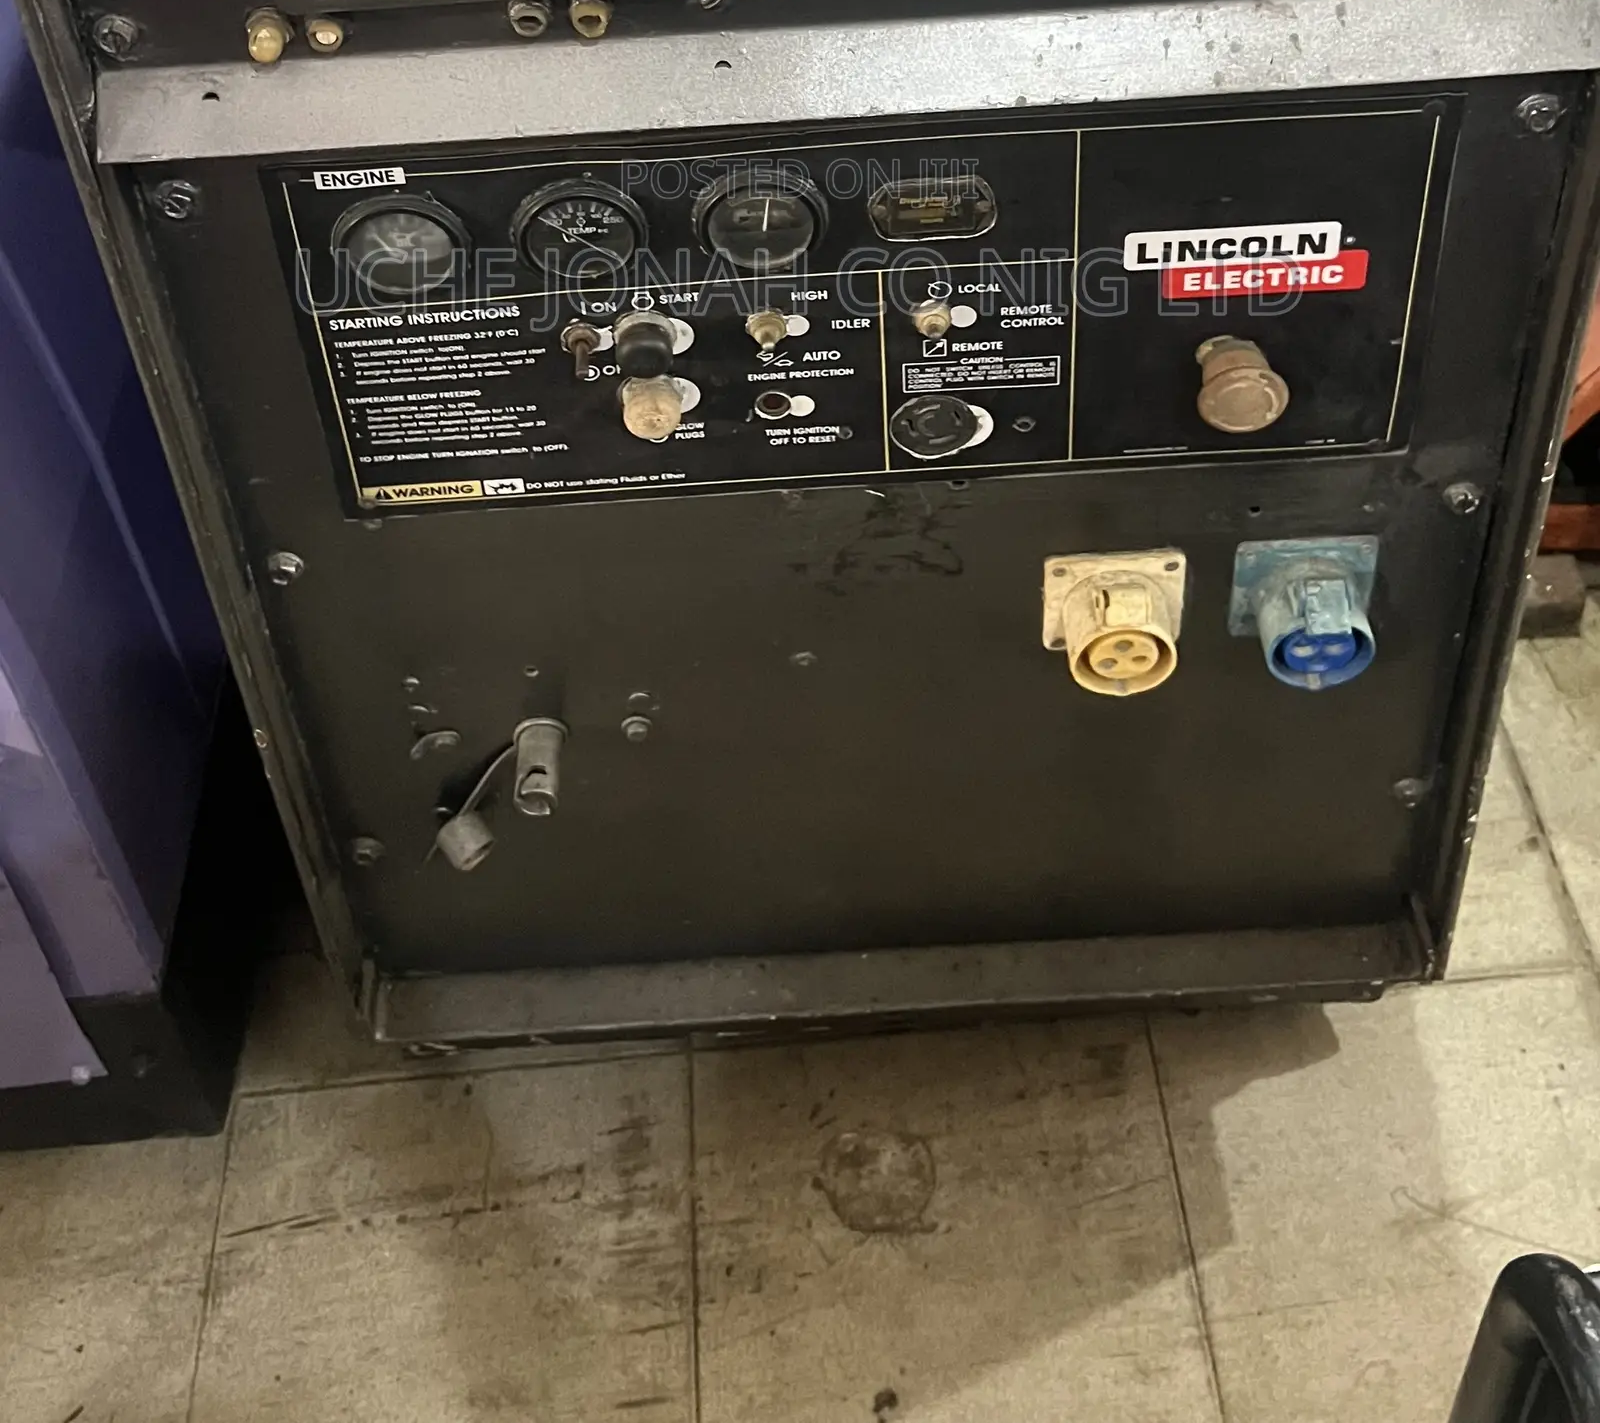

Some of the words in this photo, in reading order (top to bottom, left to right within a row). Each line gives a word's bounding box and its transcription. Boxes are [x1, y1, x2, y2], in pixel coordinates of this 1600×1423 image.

[320, 169, 396, 188] ENGINE
[1136, 232, 1328, 265] LINCOLN
[1183, 264, 1344, 292] ELECTRIC
[958, 283, 1001, 294] LOCAL
[659, 292, 700, 305] START
[791, 290, 828, 301] HIGH
[591, 302, 617, 313] ON
[1000, 305, 1053, 316] REMOTE
[329, 315, 403, 331] STARTING
[407, 306, 520, 325] INSTRUCTIONS
[831, 318, 871, 329] IDLER
[1000, 316, 1064, 328] CONTROL
[334, 338, 394, 348] TEMPERATURE
[396, 336, 426, 344] ABOVE
[428, 333, 472, 342] FREEZING
[952, 341, 1004, 352] REMOTE
[802, 350, 841, 362] AUTO
[960, 356, 1004, 365] CAUTION
[747, 372, 786, 381] ENGINE
[789, 368, 854, 379] PROTECTION
[675, 431, 705, 440] PLUGS
[793, 426, 840, 435] IGNITION
[769, 437, 789, 446] OFF
[808, 435, 836, 443] RESET
[544, 480, 565, 488] NOT
[392, 483, 475, 499] WARNING
